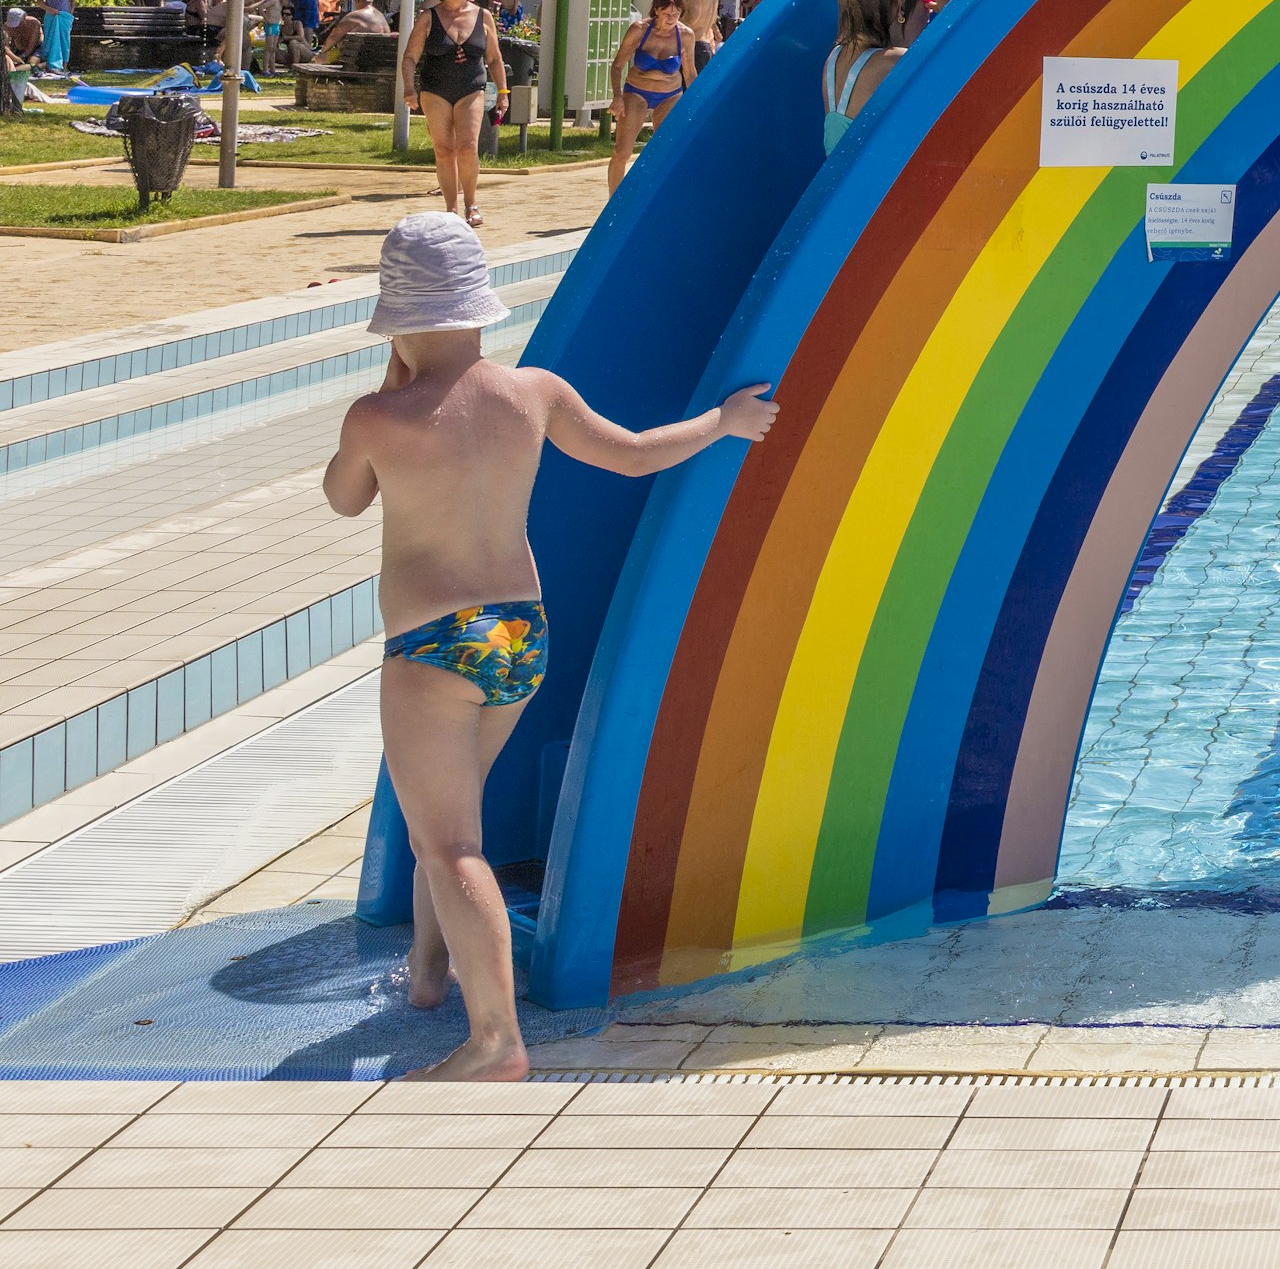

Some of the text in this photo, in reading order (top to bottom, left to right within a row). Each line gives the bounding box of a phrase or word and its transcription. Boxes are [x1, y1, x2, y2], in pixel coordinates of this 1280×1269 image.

[1056, 82, 1166, 95] A csúszda 14 éves
[1056, 99, 1164, 113] korig használható
[1050, 115, 1168, 130] szülői felügyelettel!
[1149, 192, 1182, 201] Csúszda
